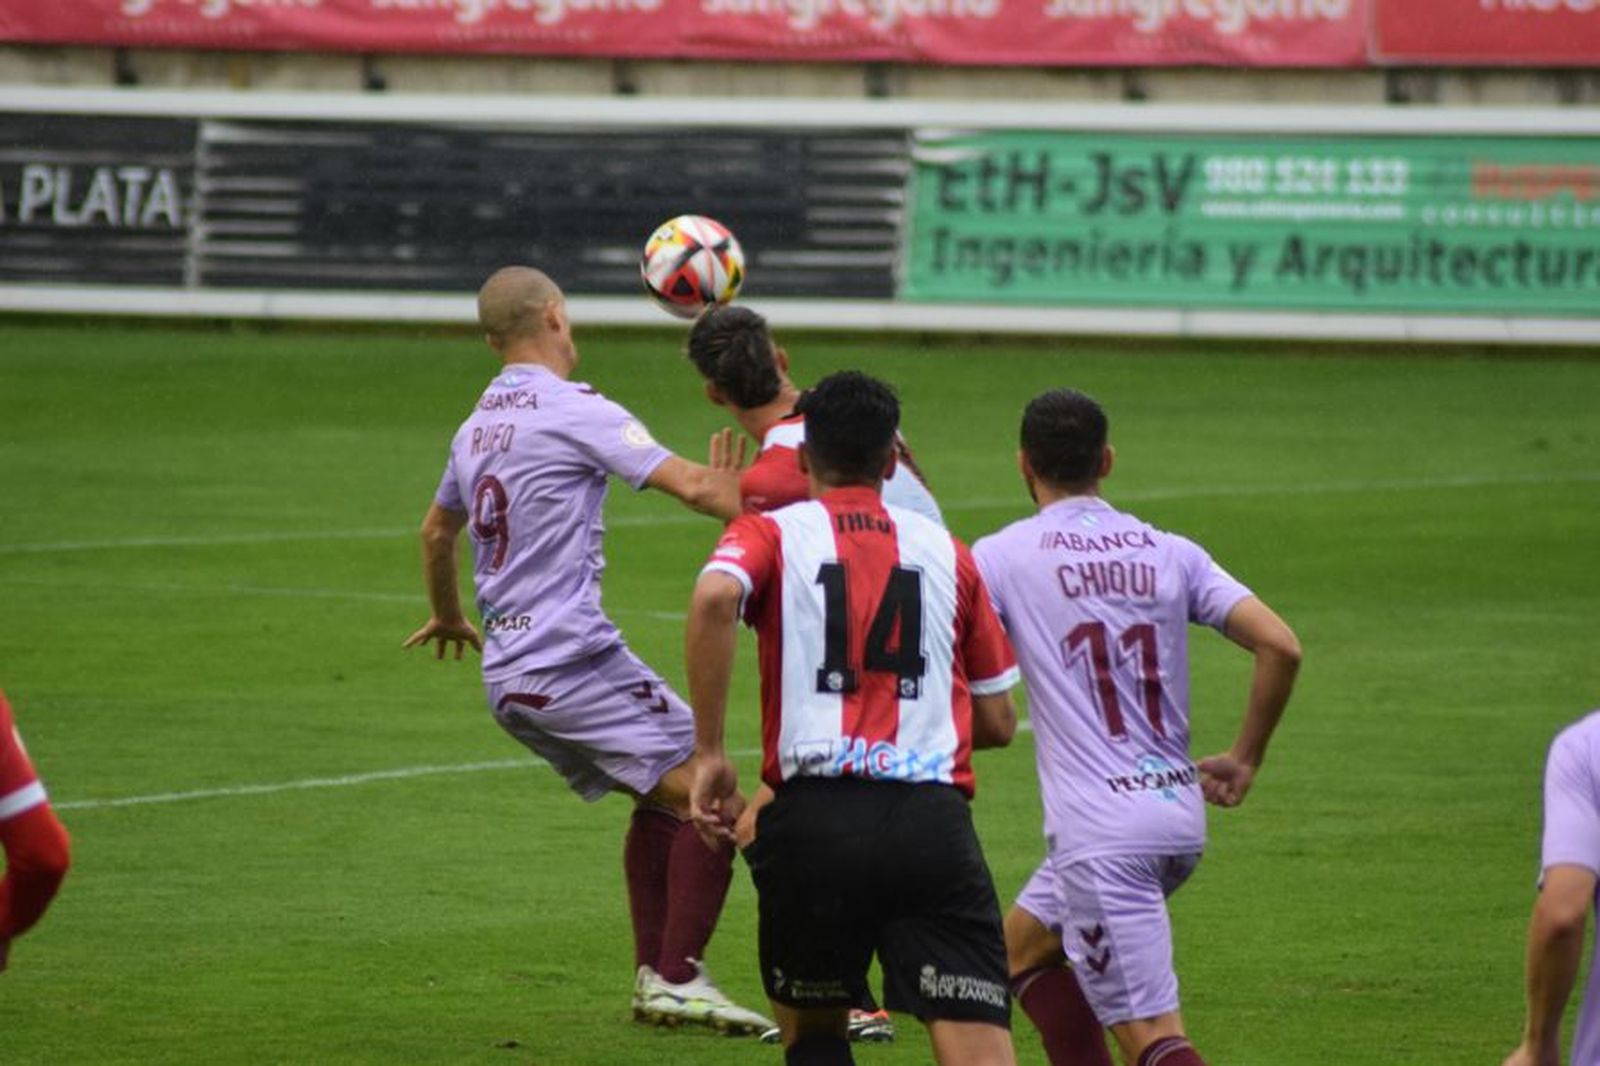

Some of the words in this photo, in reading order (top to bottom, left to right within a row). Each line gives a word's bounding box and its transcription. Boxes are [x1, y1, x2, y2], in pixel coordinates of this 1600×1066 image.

[19, 164, 181, 227] PLATA
[1226, 244, 1253, 292] y
[1276, 233, 1600, 295] Arquitectur
[471, 424, 516, 456] RUFO
[473, 474, 510, 576] 9
[1052, 530, 1157, 554] ABANCA
[1058, 560, 1156, 599] CHIQUI
[814, 558, 929, 701] 14
[1061, 620, 1168, 744] 11
